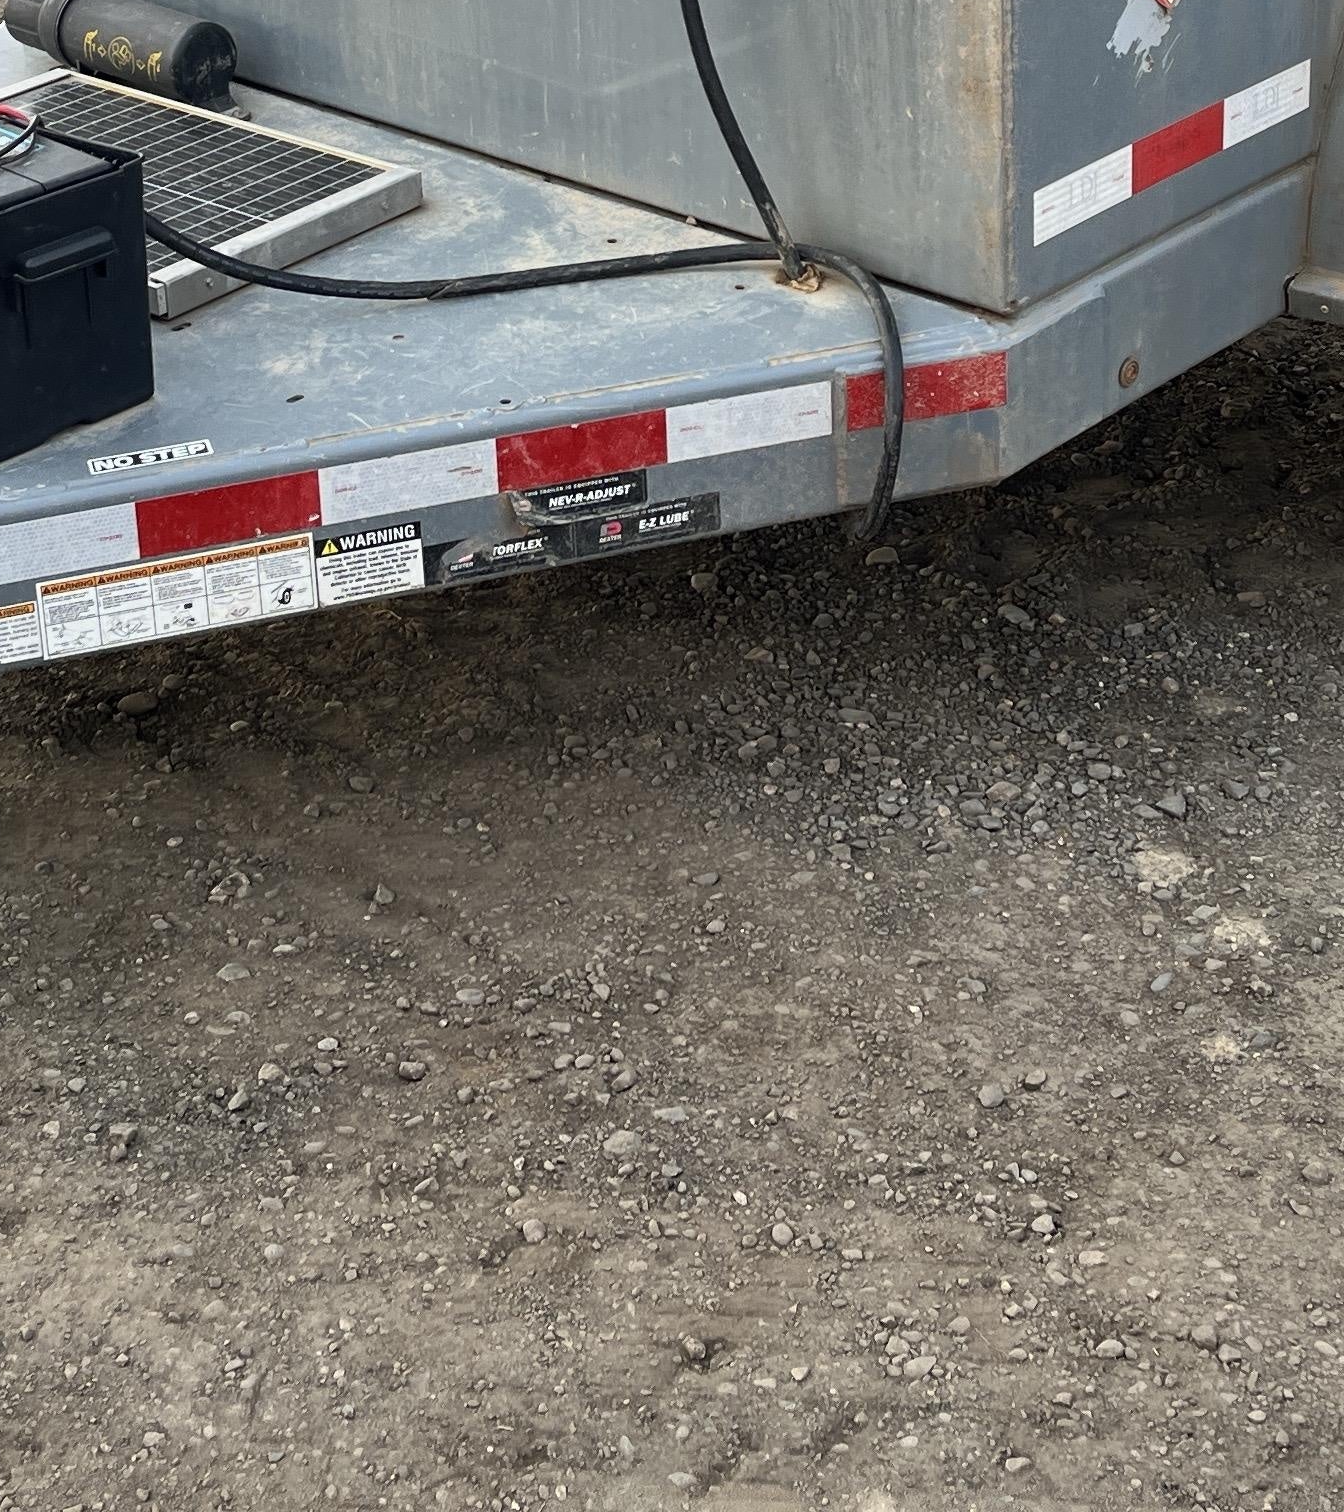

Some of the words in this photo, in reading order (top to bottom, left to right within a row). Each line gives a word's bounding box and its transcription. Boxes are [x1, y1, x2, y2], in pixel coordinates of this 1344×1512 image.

[93, 456, 134, 471] NO
[138, 443, 207, 463] STEP
[548, 484, 632, 508] NEV-R-ADJUST
[659, 510, 690, 526] LUBE
[339, 524, 416, 551] WARNING
[159, 558, 203, 573] WARNING
[50, 579, 94, 593] WARNING
